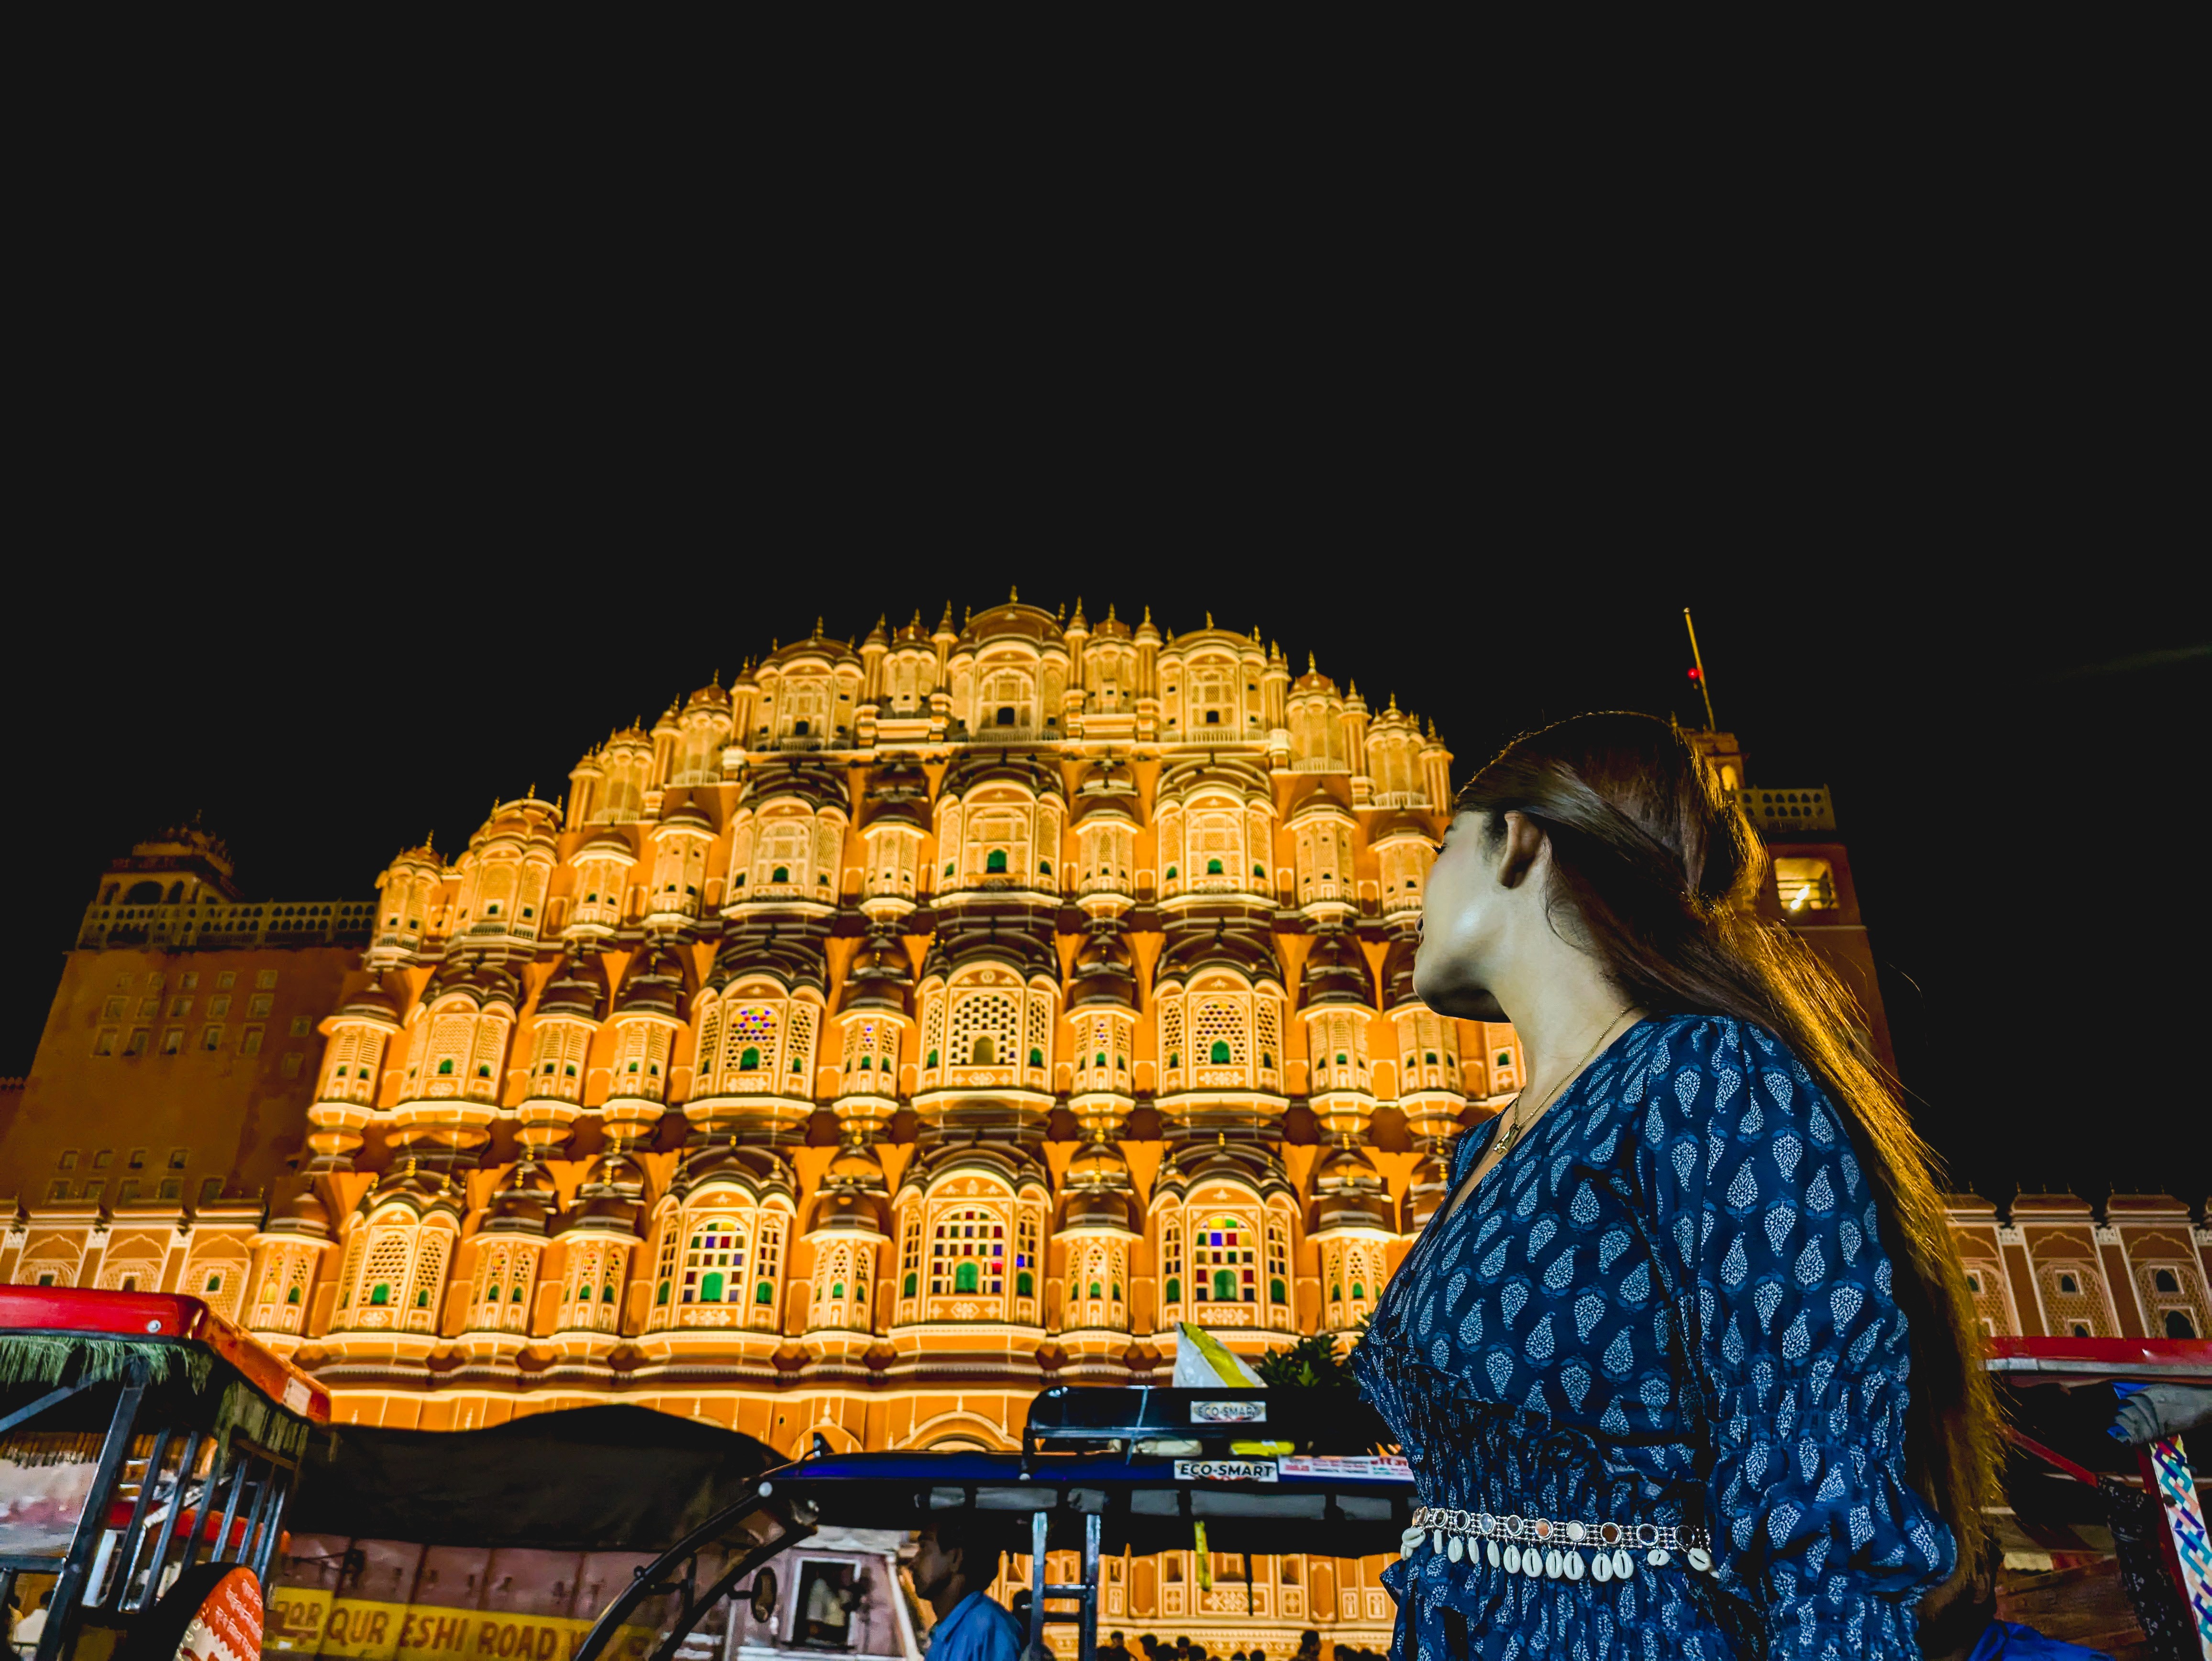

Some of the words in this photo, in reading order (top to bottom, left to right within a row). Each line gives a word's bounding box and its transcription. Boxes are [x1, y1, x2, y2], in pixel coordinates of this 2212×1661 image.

[1198, 1406, 1260, 1417] ECO-SMART
[1180, 1463, 1274, 1477] ECO-SMART
[479, 1621, 557, 1661] ROAD
